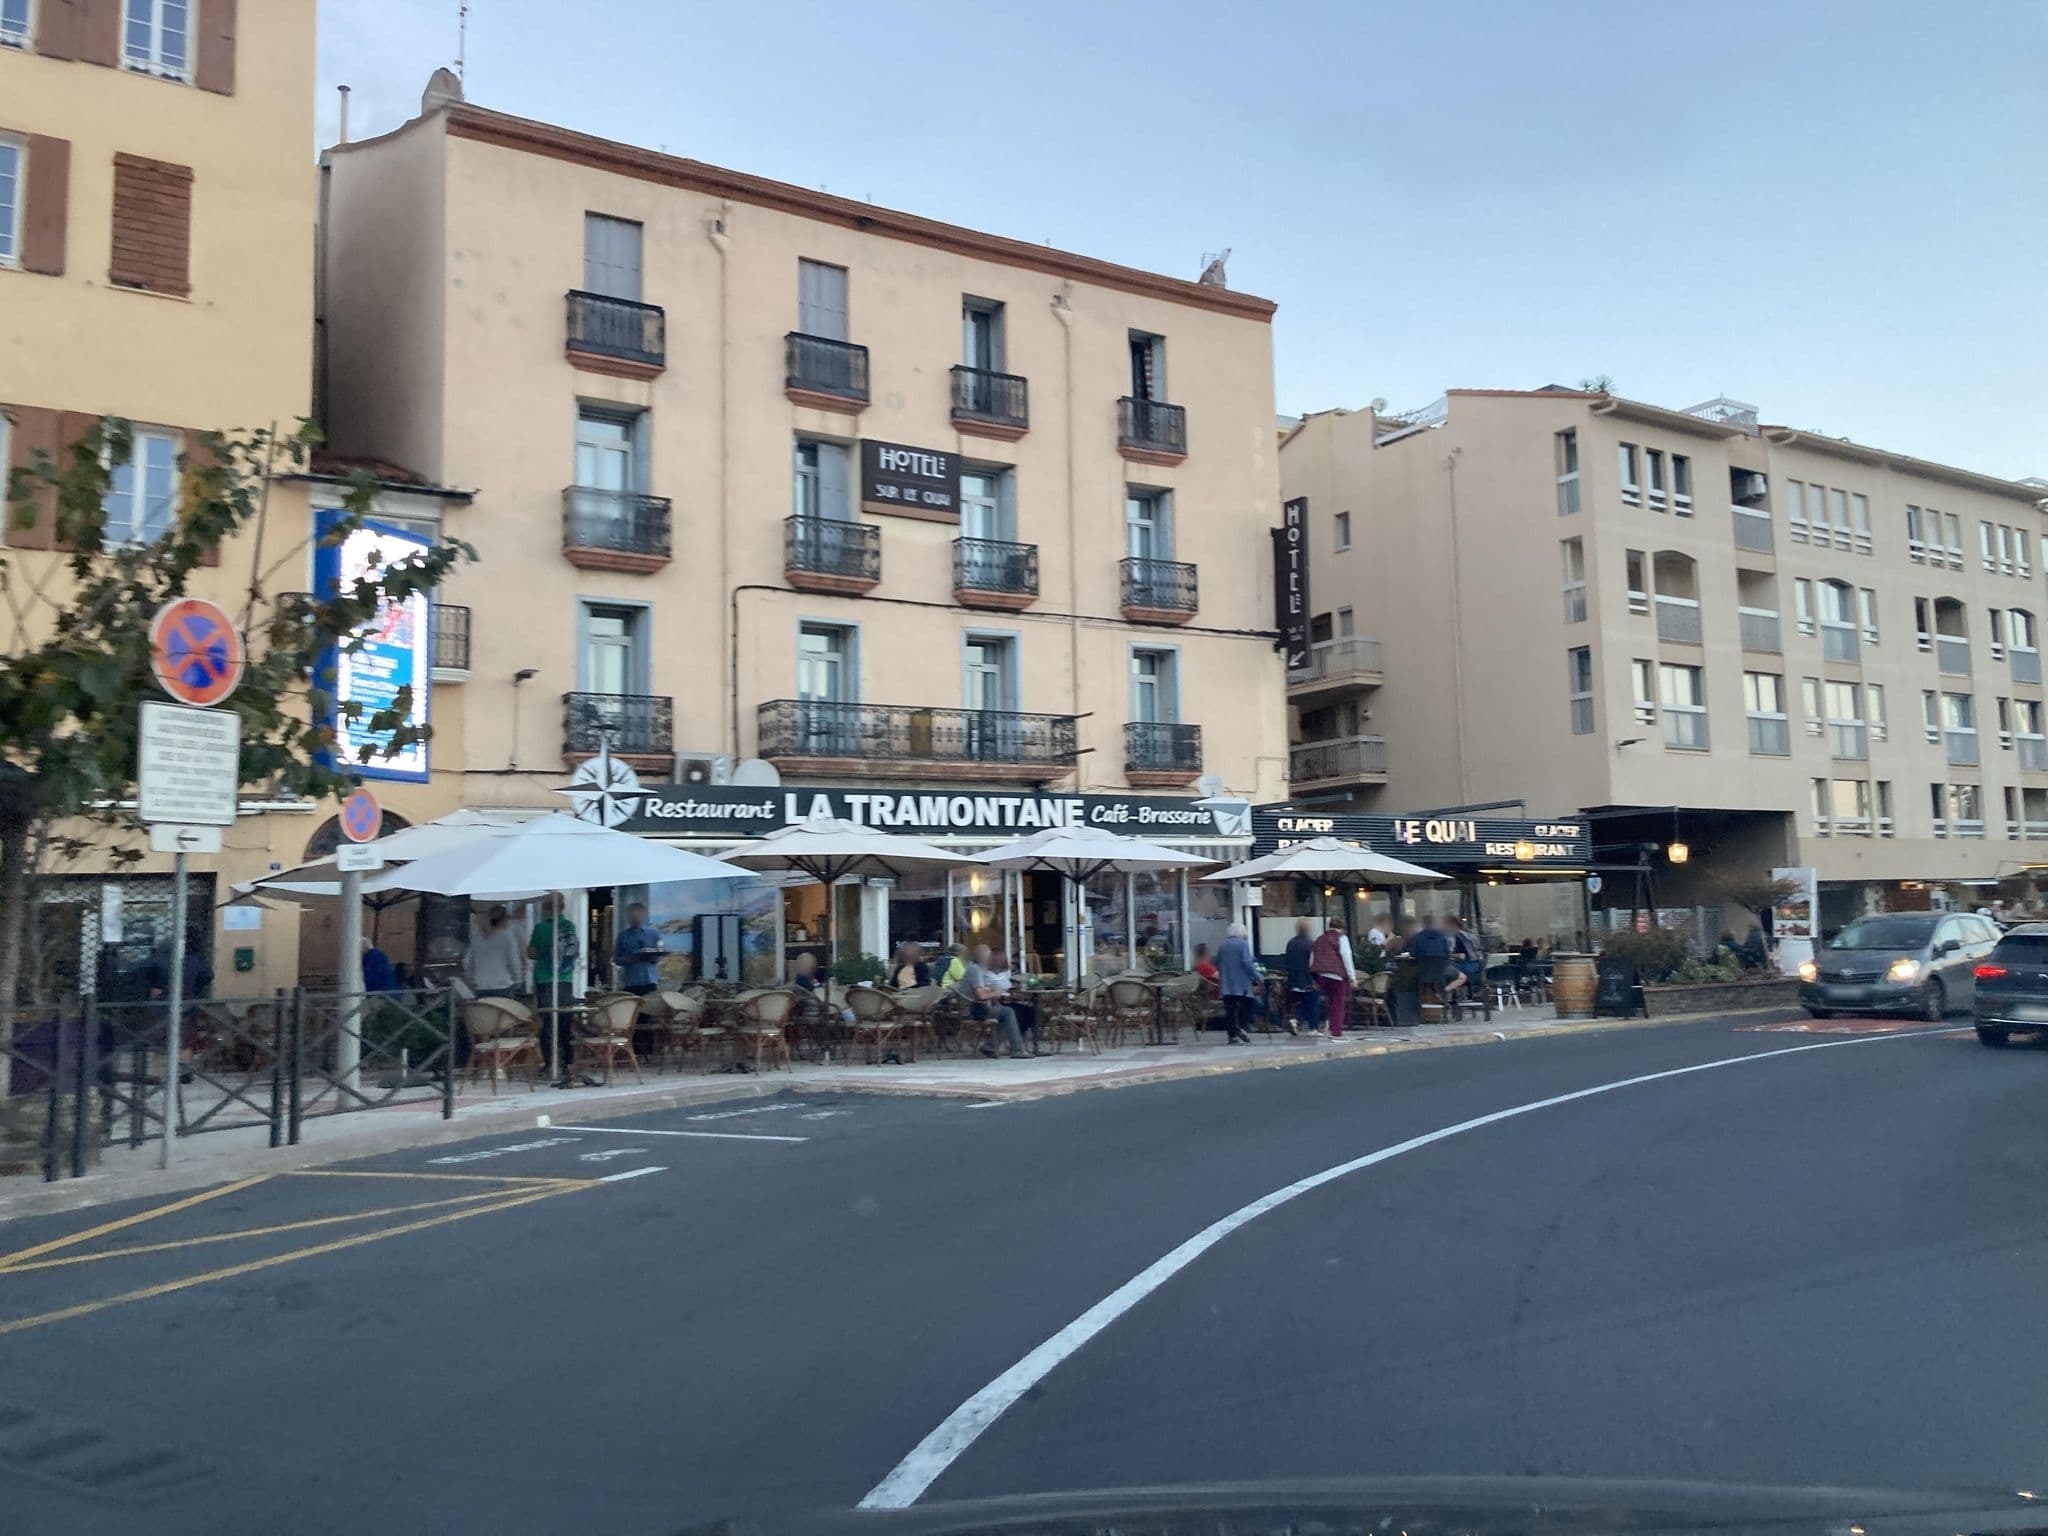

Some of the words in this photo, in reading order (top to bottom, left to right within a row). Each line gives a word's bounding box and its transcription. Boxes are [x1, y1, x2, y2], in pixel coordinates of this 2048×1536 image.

[644, 797, 777, 819] Restaurant
[784, 792, 835, 825] LA
[843, 794, 1086, 827] TRAMONTANE
[1394, 820, 1421, 843] LE
[1425, 820, 1476, 843] QUAI
[1485, 842, 1575, 856] RESRANT
